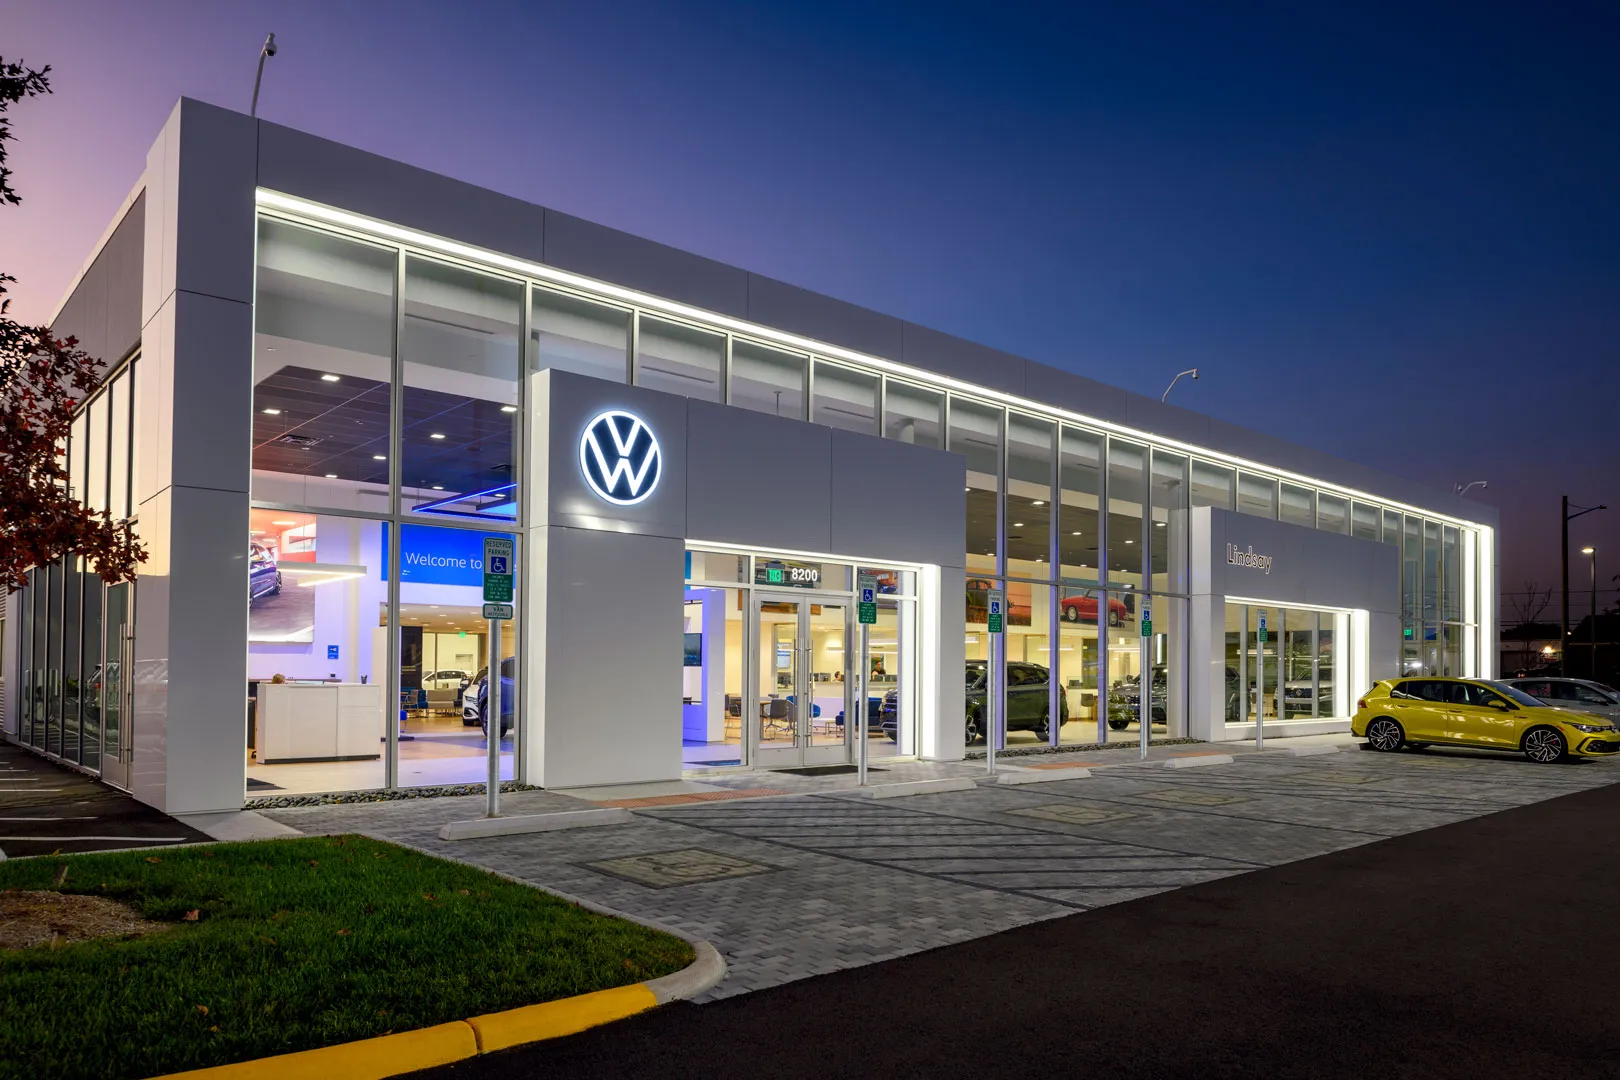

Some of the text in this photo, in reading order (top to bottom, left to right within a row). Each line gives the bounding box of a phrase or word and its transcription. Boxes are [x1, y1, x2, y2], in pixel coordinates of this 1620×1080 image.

[486, 540, 512, 549] RESERVED
[487, 548, 511, 557] PARKING
[1227, 542, 1272, 575] Lindsay
[405, 551, 483, 570] Welcome to
[791, 568, 818, 582] 8200
